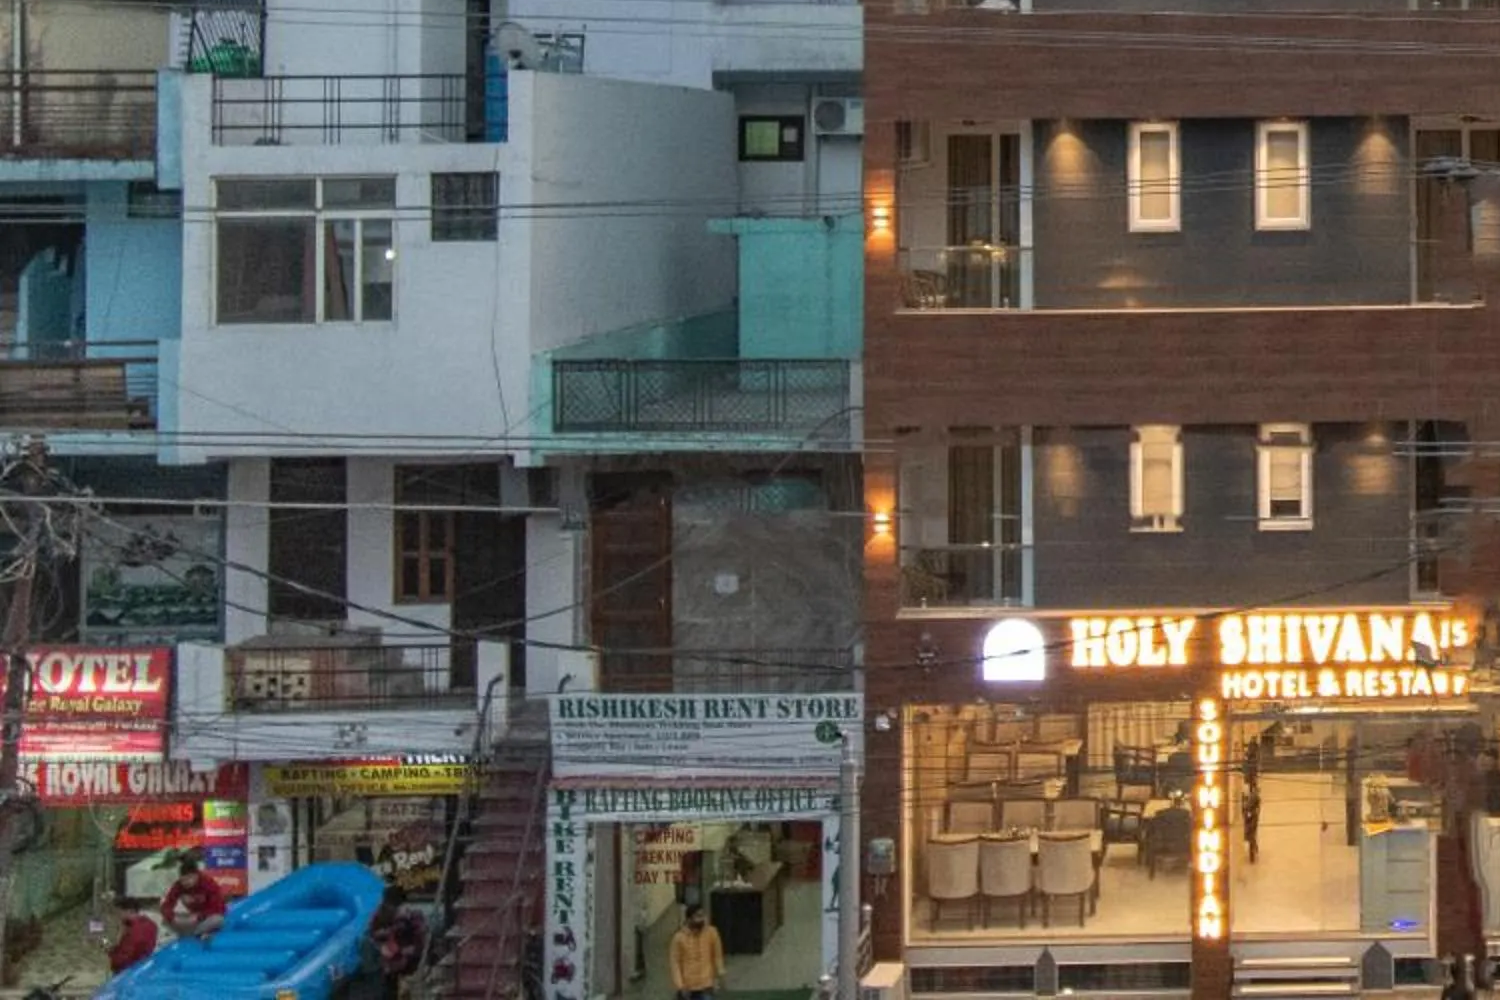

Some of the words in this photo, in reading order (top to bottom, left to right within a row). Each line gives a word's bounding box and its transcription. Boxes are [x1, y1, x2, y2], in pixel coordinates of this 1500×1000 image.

[1070, 617, 1196, 667] HOLY
[1222, 671, 1312, 698] HOTEL
[558, 699, 697, 718] RISHIKESH
[704, 698, 769, 718] RENT
[777, 698, 860, 718] STORE
[128, 758, 219, 795] GALAXY
[280, 767, 347, 780] RAFTING
[361, 767, 430, 779] CAMPING
[585, 788, 664, 813] RAFTING
[635, 830, 694, 844] CAMPING
[636, 871, 658, 885] DAY
